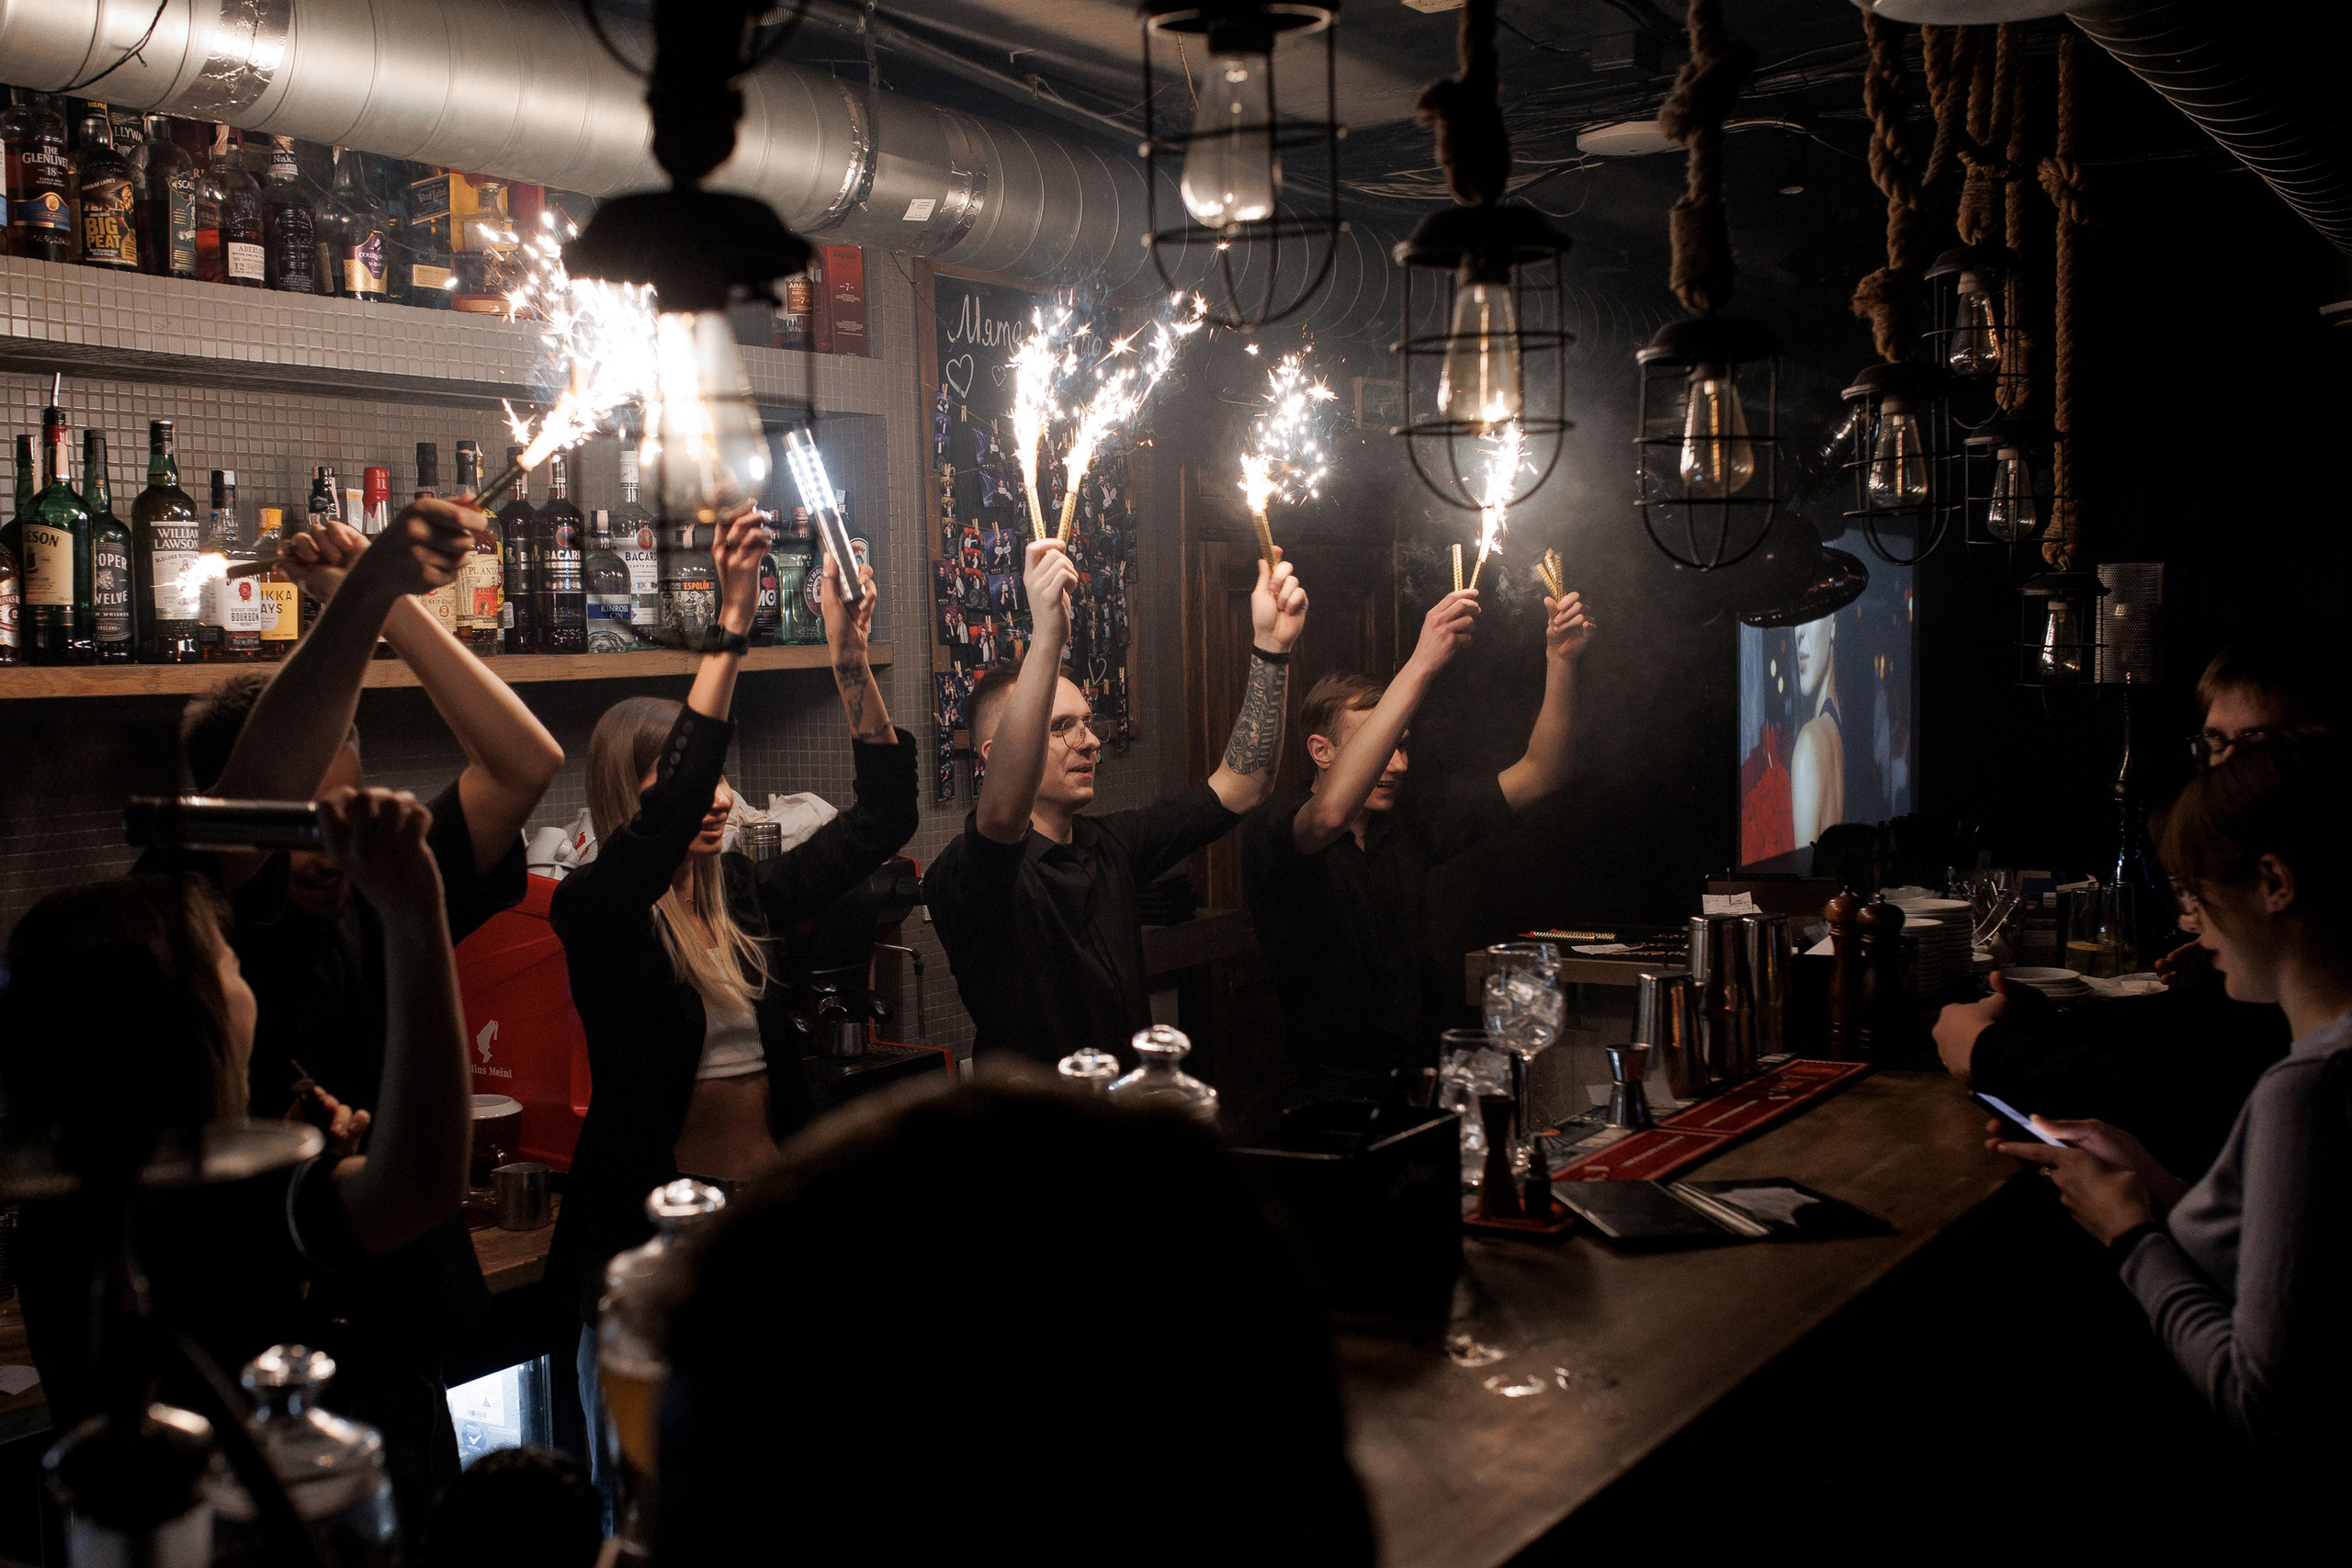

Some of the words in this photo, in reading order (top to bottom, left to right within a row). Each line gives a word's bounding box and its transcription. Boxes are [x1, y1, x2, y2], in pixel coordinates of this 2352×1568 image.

[42, 145, 58, 155] THE
[22, 152, 69, 170] GLENLIVET
[46, 166, 57, 177] 18
[85, 217, 119, 235] BIG
[87, 234, 122, 249] PEAT
[234, 262, 245, 272] 12
[845, 282, 851, 292] 7
[800, 296, 806, 305] 7
[946, 294, 1023, 355] Мята
[96, 553, 128, 571] OPER
[154, 554, 177, 564] BLENDED
[600, 604, 629, 613] KINROSS
[231, 613, 260, 622] BOURBON
[488, 1066, 513, 1078] Meinl
